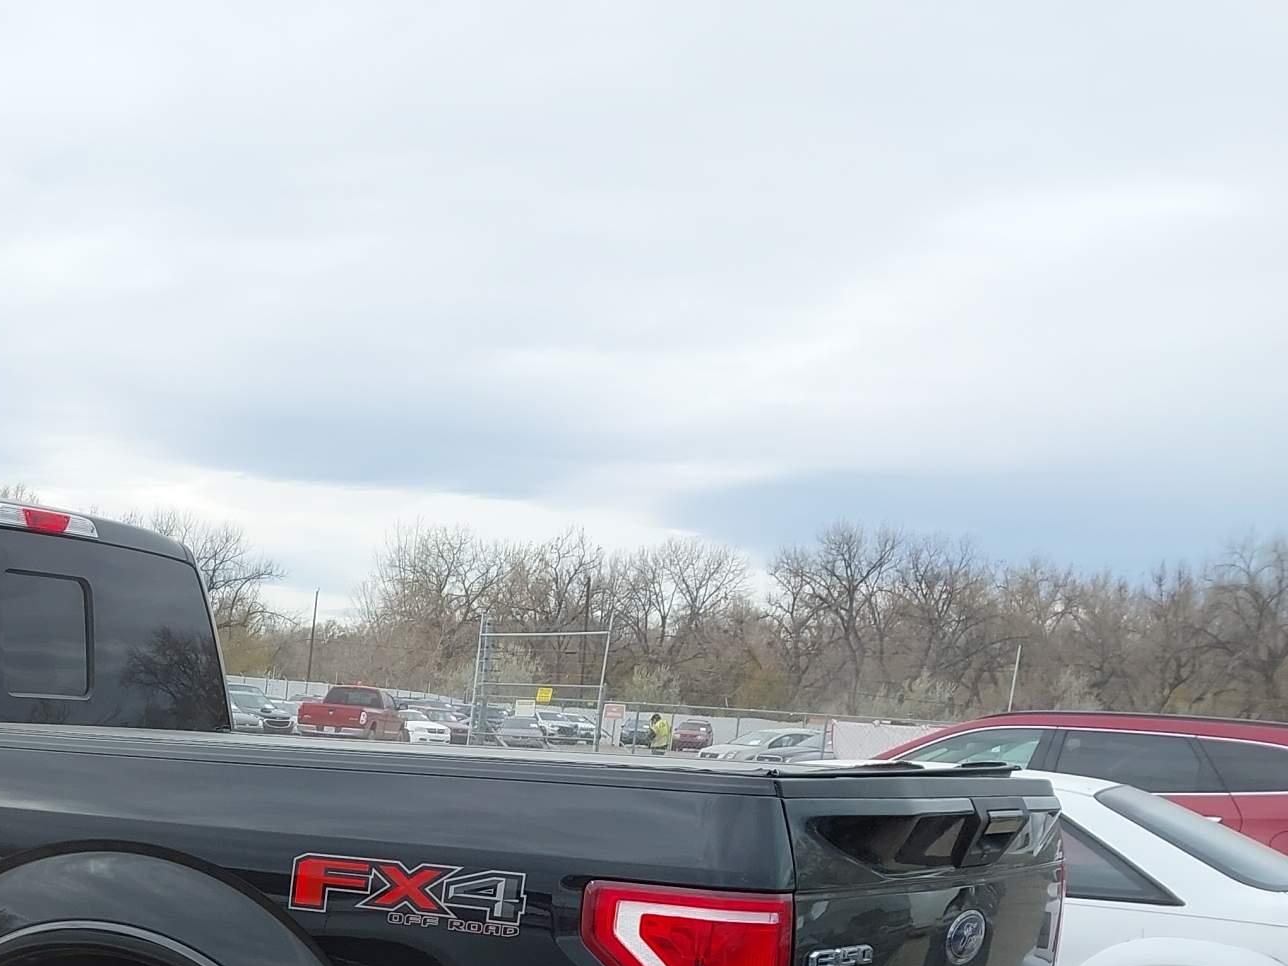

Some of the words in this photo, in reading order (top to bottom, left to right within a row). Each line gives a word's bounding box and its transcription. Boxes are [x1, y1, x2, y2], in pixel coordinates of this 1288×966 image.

[288, 852, 527, 926] FX4
[386, 912, 440, 928] OFF
[447, 918, 521, 938] ROAD
